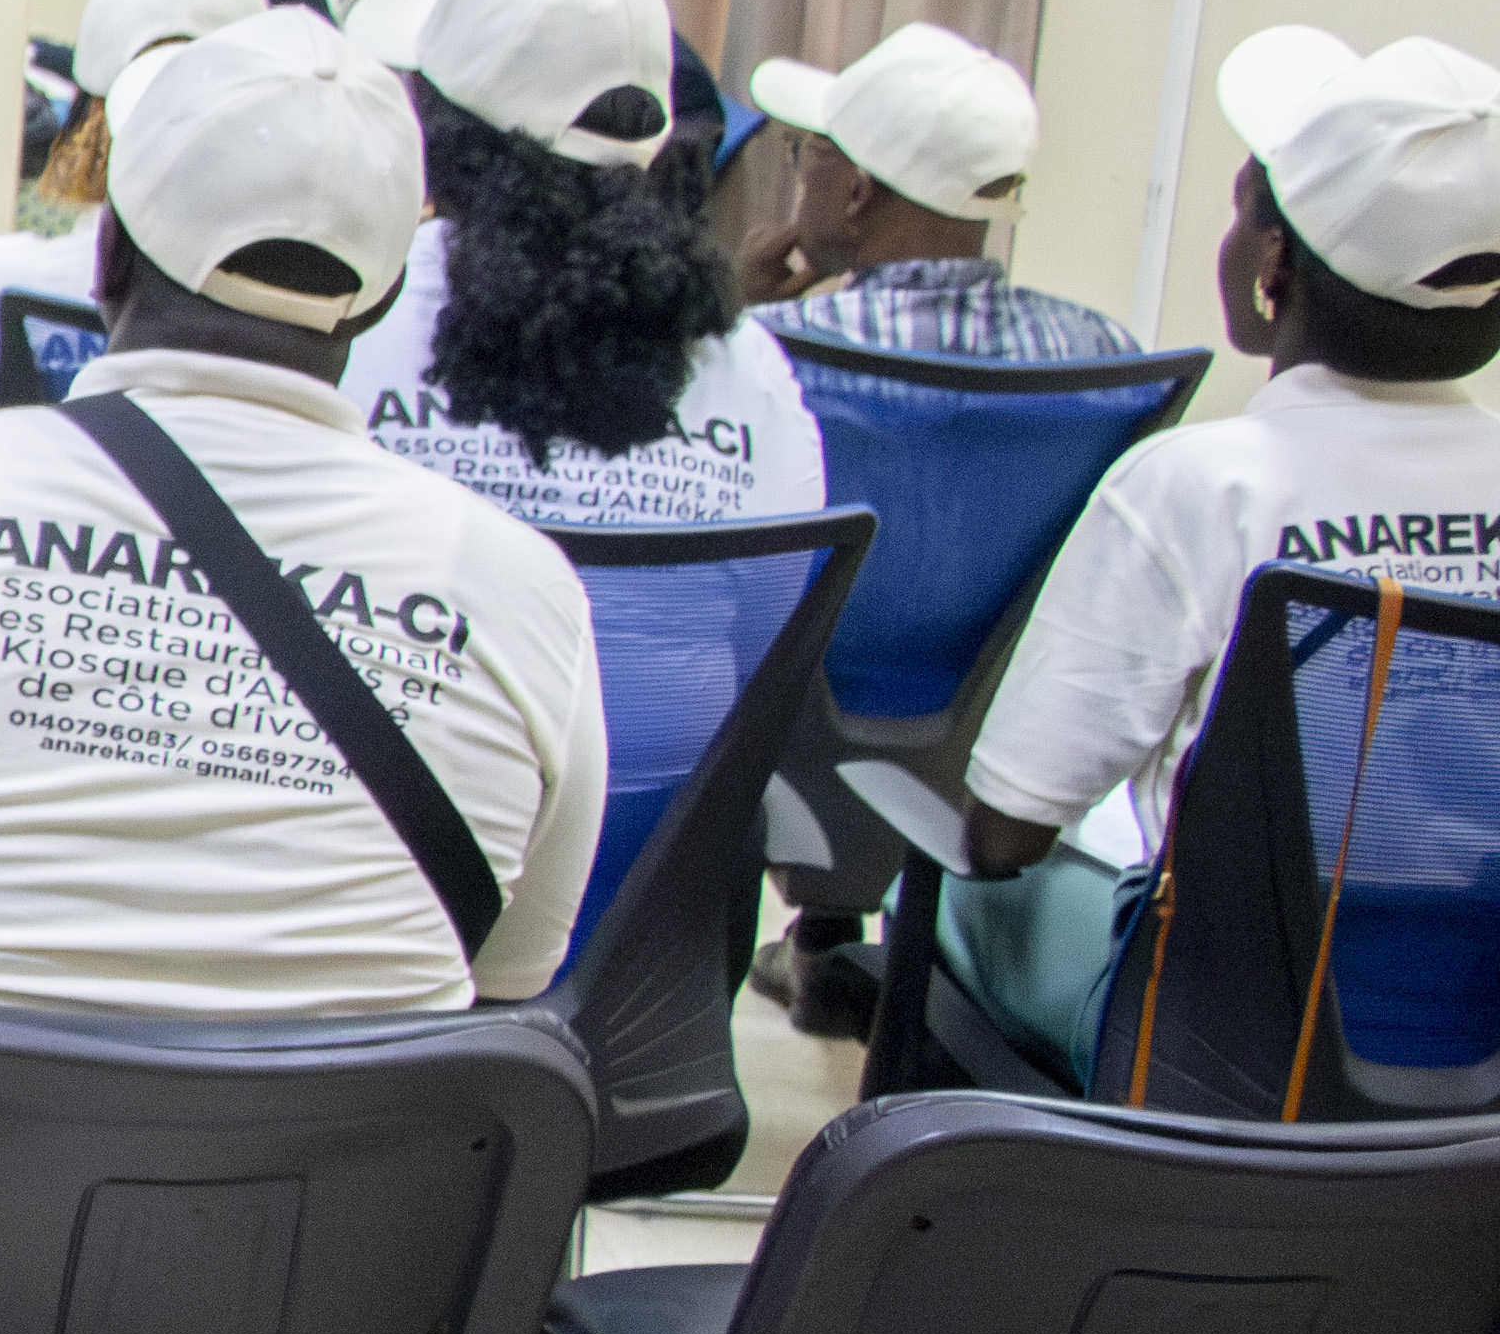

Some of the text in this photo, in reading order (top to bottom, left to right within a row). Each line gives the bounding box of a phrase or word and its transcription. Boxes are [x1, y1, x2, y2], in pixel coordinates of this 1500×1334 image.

[625, 443, 755, 491] ationale
[717, 486, 743, 511] et
[1, 634, 188, 689] Kiosque
[63, 613, 384, 691] Restauras
[401, 676, 444, 708] et
[17, 673, 75, 702] de
[92, 684, 194, 723] côte
[8, 709, 356, 782] 0140796083/ 056697794
[39, 733, 335, 797] anarekaci@gmail.com
